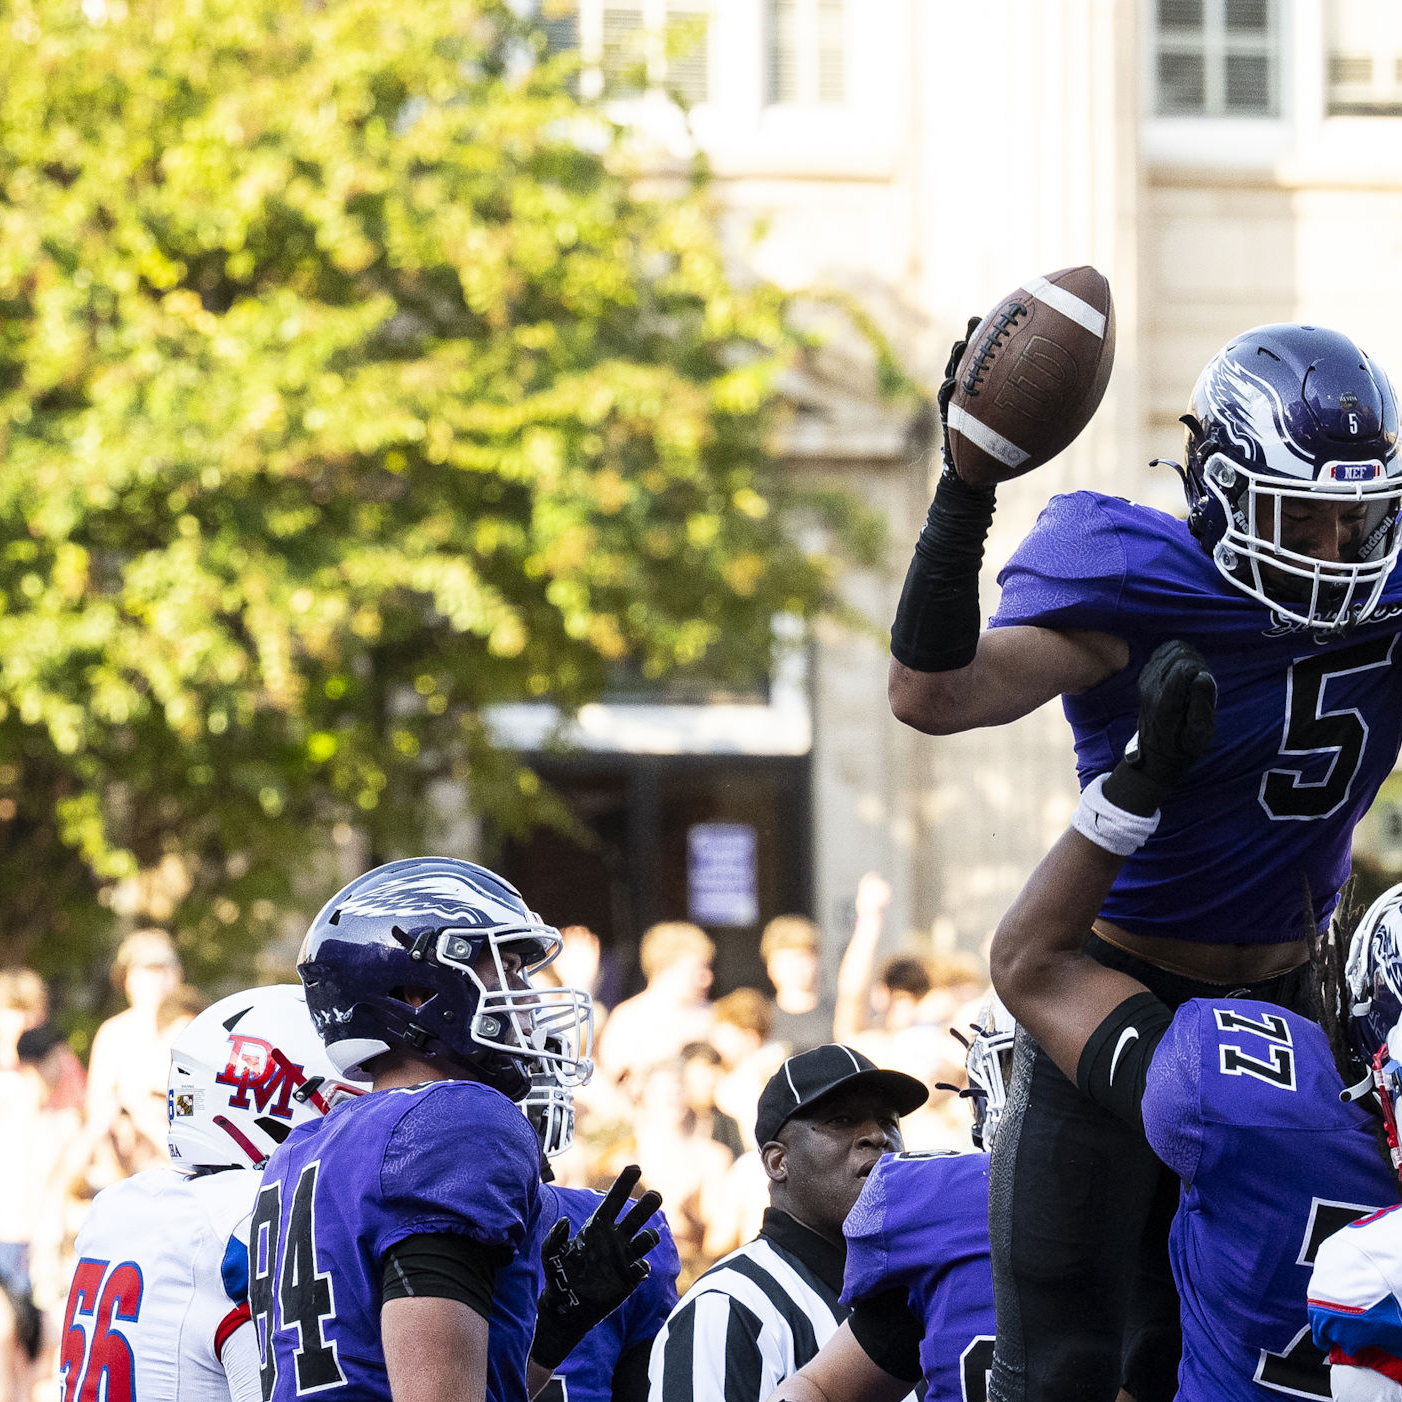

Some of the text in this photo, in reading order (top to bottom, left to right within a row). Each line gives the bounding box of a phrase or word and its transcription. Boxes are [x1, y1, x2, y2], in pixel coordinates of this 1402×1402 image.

[1348, 413, 1358, 434] 5
[1258, 632, 1401, 822] 5
[1212, 1008, 1297, 1092] 77
